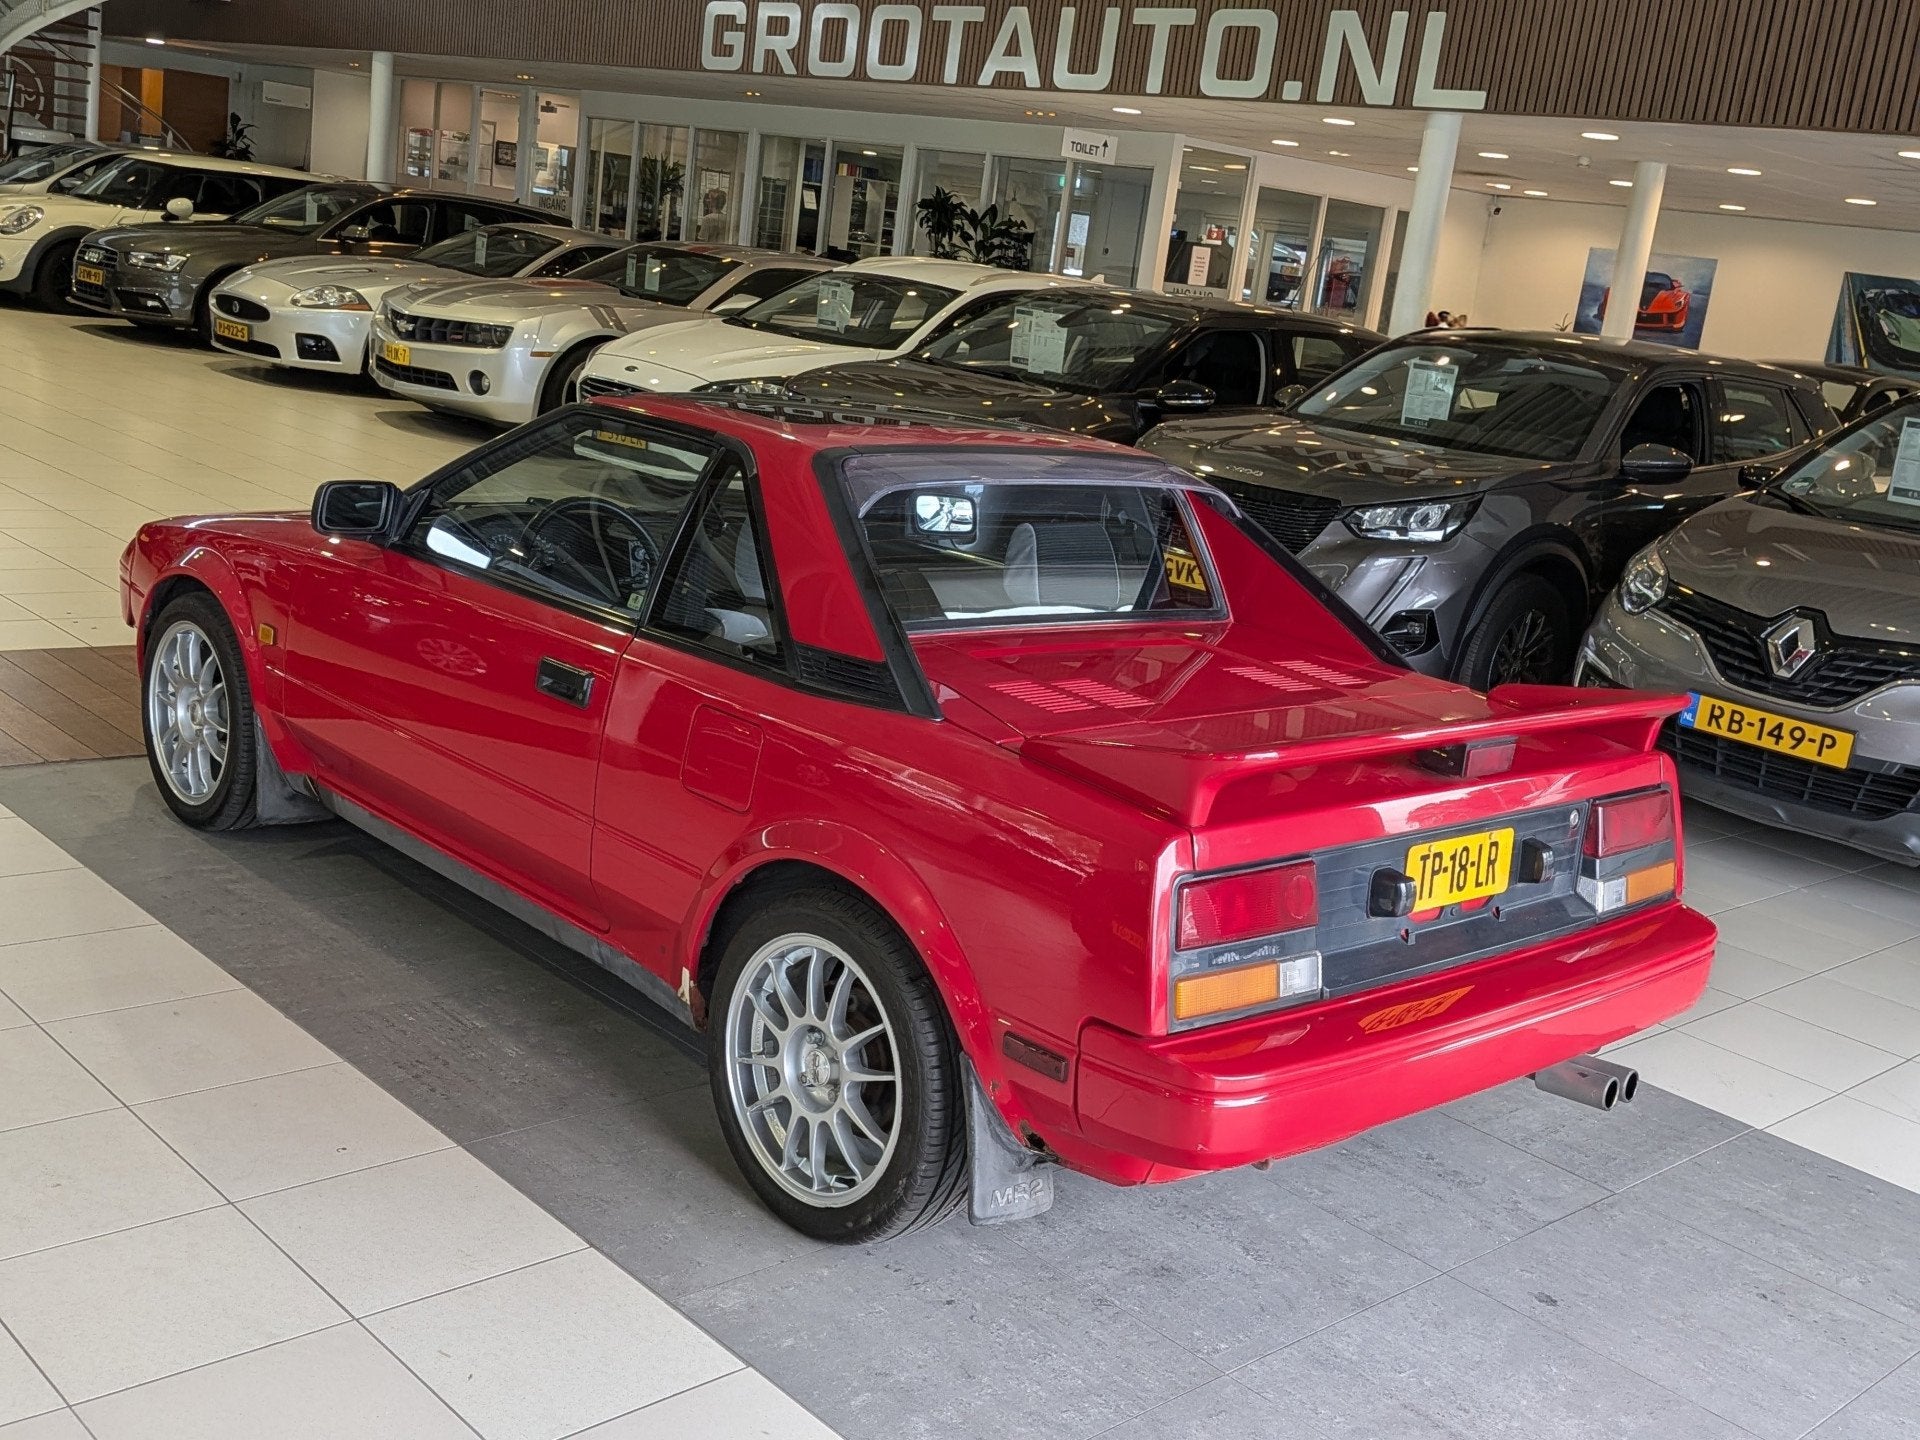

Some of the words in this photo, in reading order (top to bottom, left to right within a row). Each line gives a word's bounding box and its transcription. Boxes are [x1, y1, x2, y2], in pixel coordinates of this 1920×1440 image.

[700, 0, 1487, 110] GROOTAUTO.NL
[1070, 140, 1101, 157] TOILET
[538, 196, 567, 212] INGANG
[1683, 711, 1695, 722] NL
[1707, 703, 1838, 757] RB-149-P
[1418, 840, 1500, 901] TP-18-LR
[990, 1177, 1045, 1209] MR2
